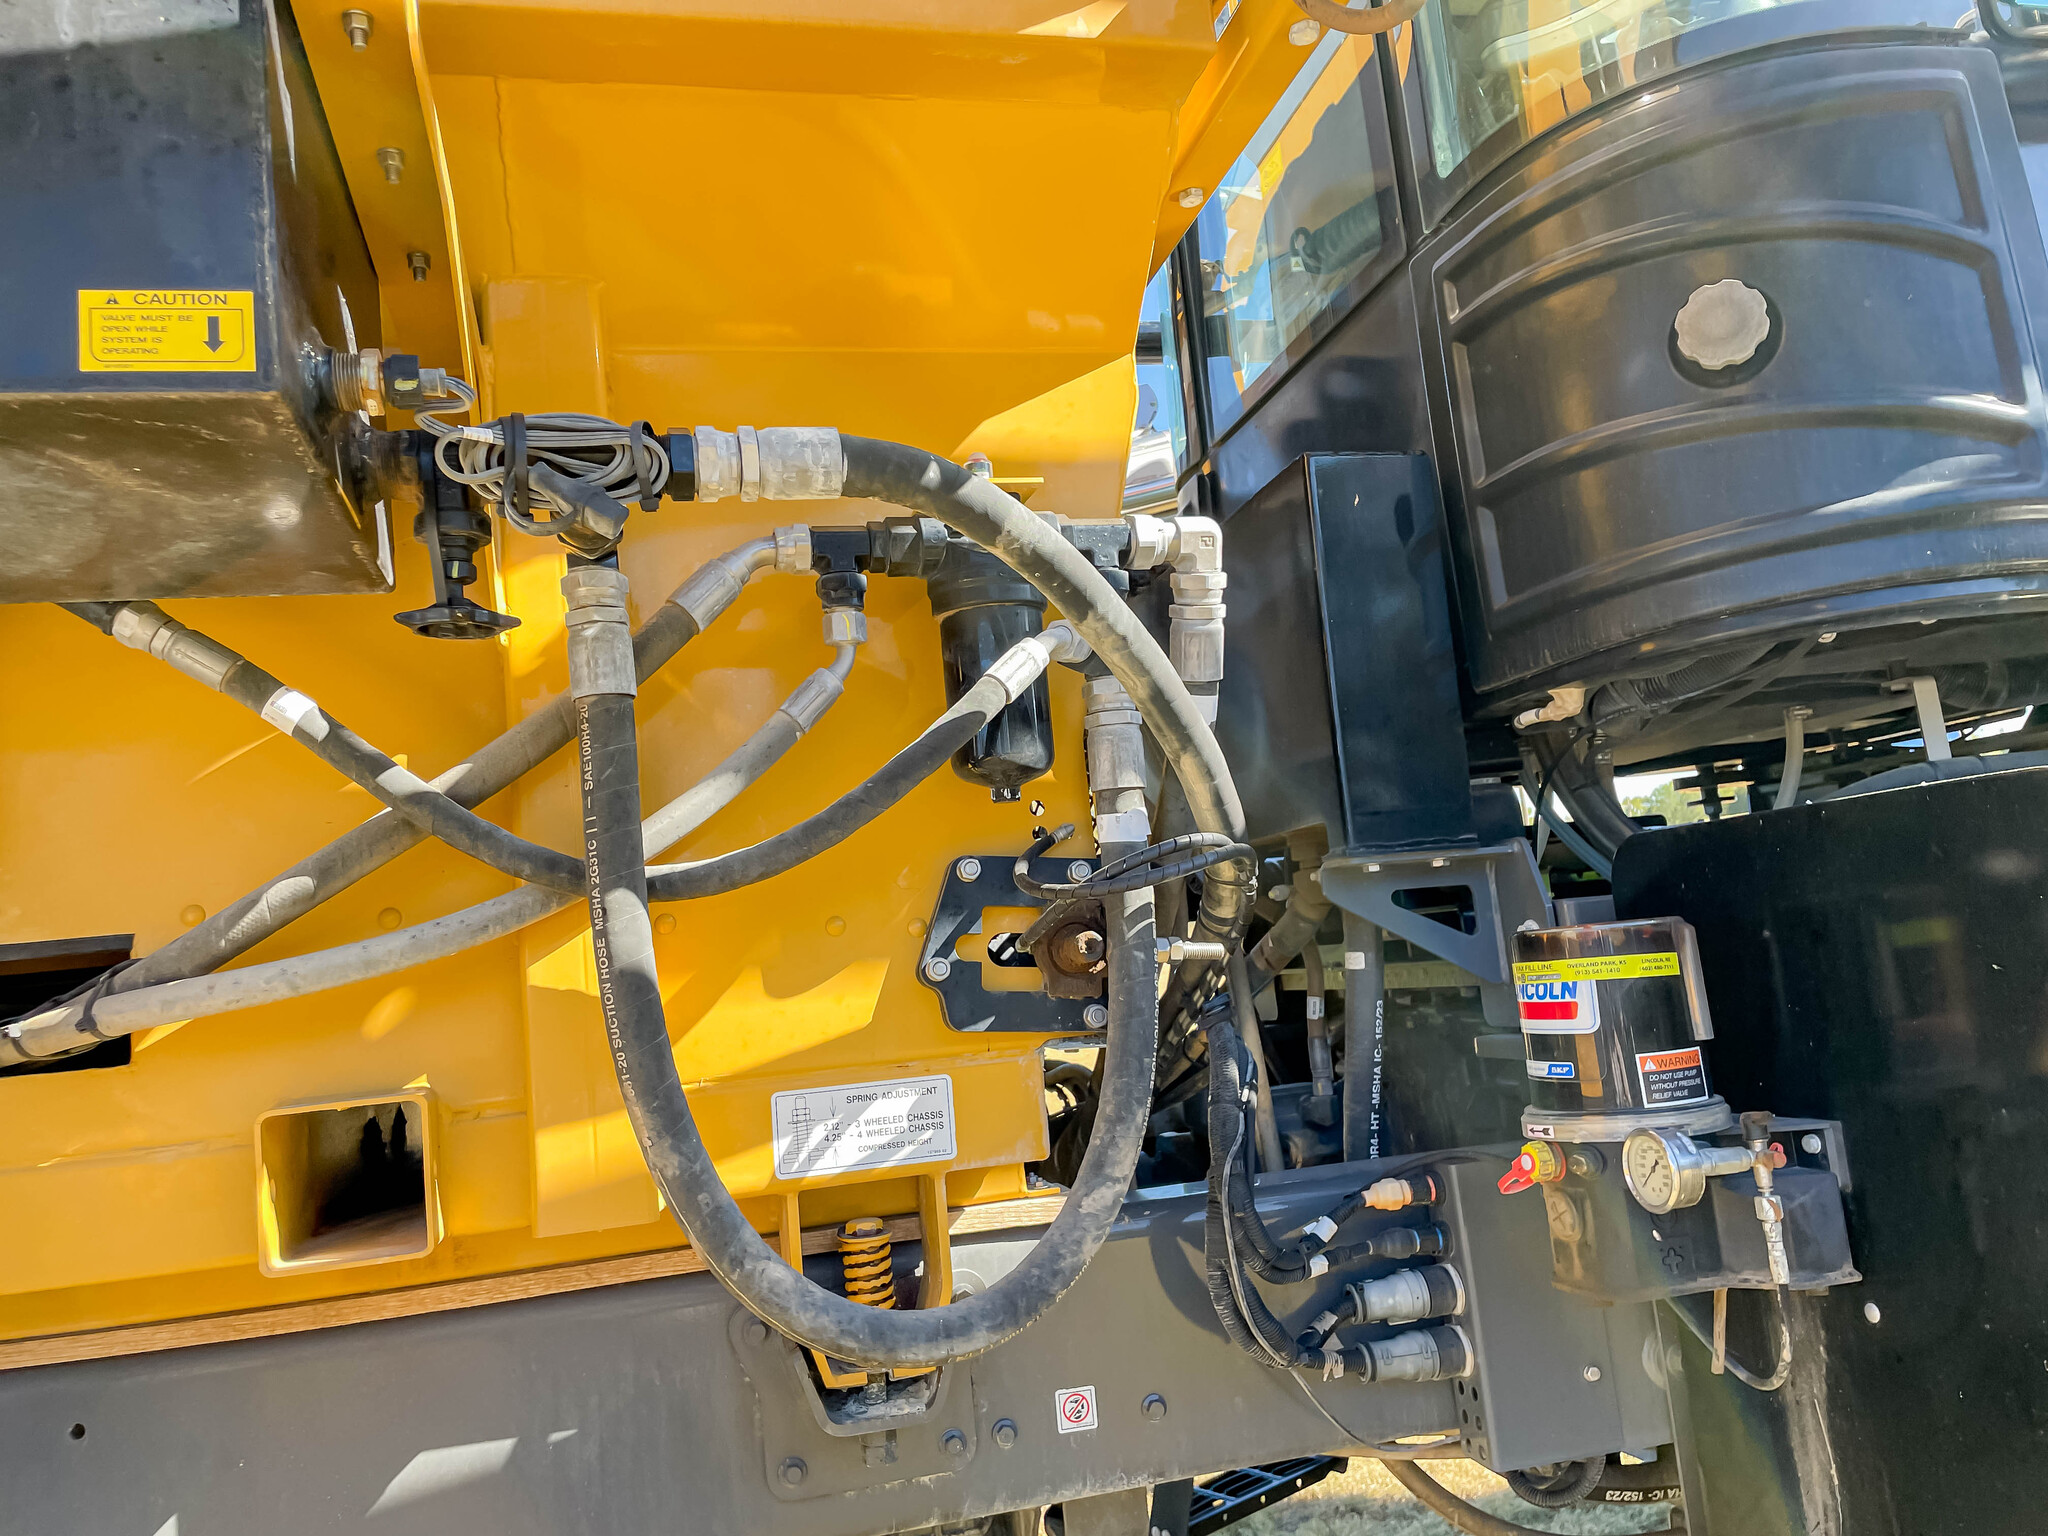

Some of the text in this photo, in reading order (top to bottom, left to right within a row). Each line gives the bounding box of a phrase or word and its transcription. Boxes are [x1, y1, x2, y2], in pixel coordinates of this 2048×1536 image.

[133, 293, 228, 306] CAUTION
[101, 314, 193, 322] VALVE MUST BE
[101, 325, 168, 333] OPEN WHILE
[101, 336, 162, 344] SYSTEM IS
[102, 347, 159, 355] OPERATING
[591, 887, 605, 930] MSHA
[596, 937, 610, 979] HOSE
[1567, 961, 1599, 969] OVERLAND
[601, 983, 623, 1049] SUCTION
[1374, 1000, 1384, 1040] 152/23
[1656, 1053, 1700, 1069] WARNING
[1649, 1074, 1660, 1082] DO
[1660, 1073, 1672, 1081] NOT
[1673, 1071, 1684, 1079] USE
[1650, 1081, 1678, 1091] WITHOUT
[846, 1086, 938, 1104] SPRING ADJUSTMENT
[1652, 1089, 1689, 1100] RELIEF VALVE
[854, 1119, 861, 1128] 3
[863, 1115, 904, 1127] WHEELED
[907, 1110, 944, 1123] CHASSIS
[1370, 1112, 1380, 1130] HT
[857, 1130, 863, 1139] 4
[866, 1126, 906, 1138] WHEELED
[908, 1121, 945, 1134] CHASSIS
[858, 1137, 933, 1153] COMPRESSED HEIGHT
[1605, 1490, 1644, 1501] 152/23
